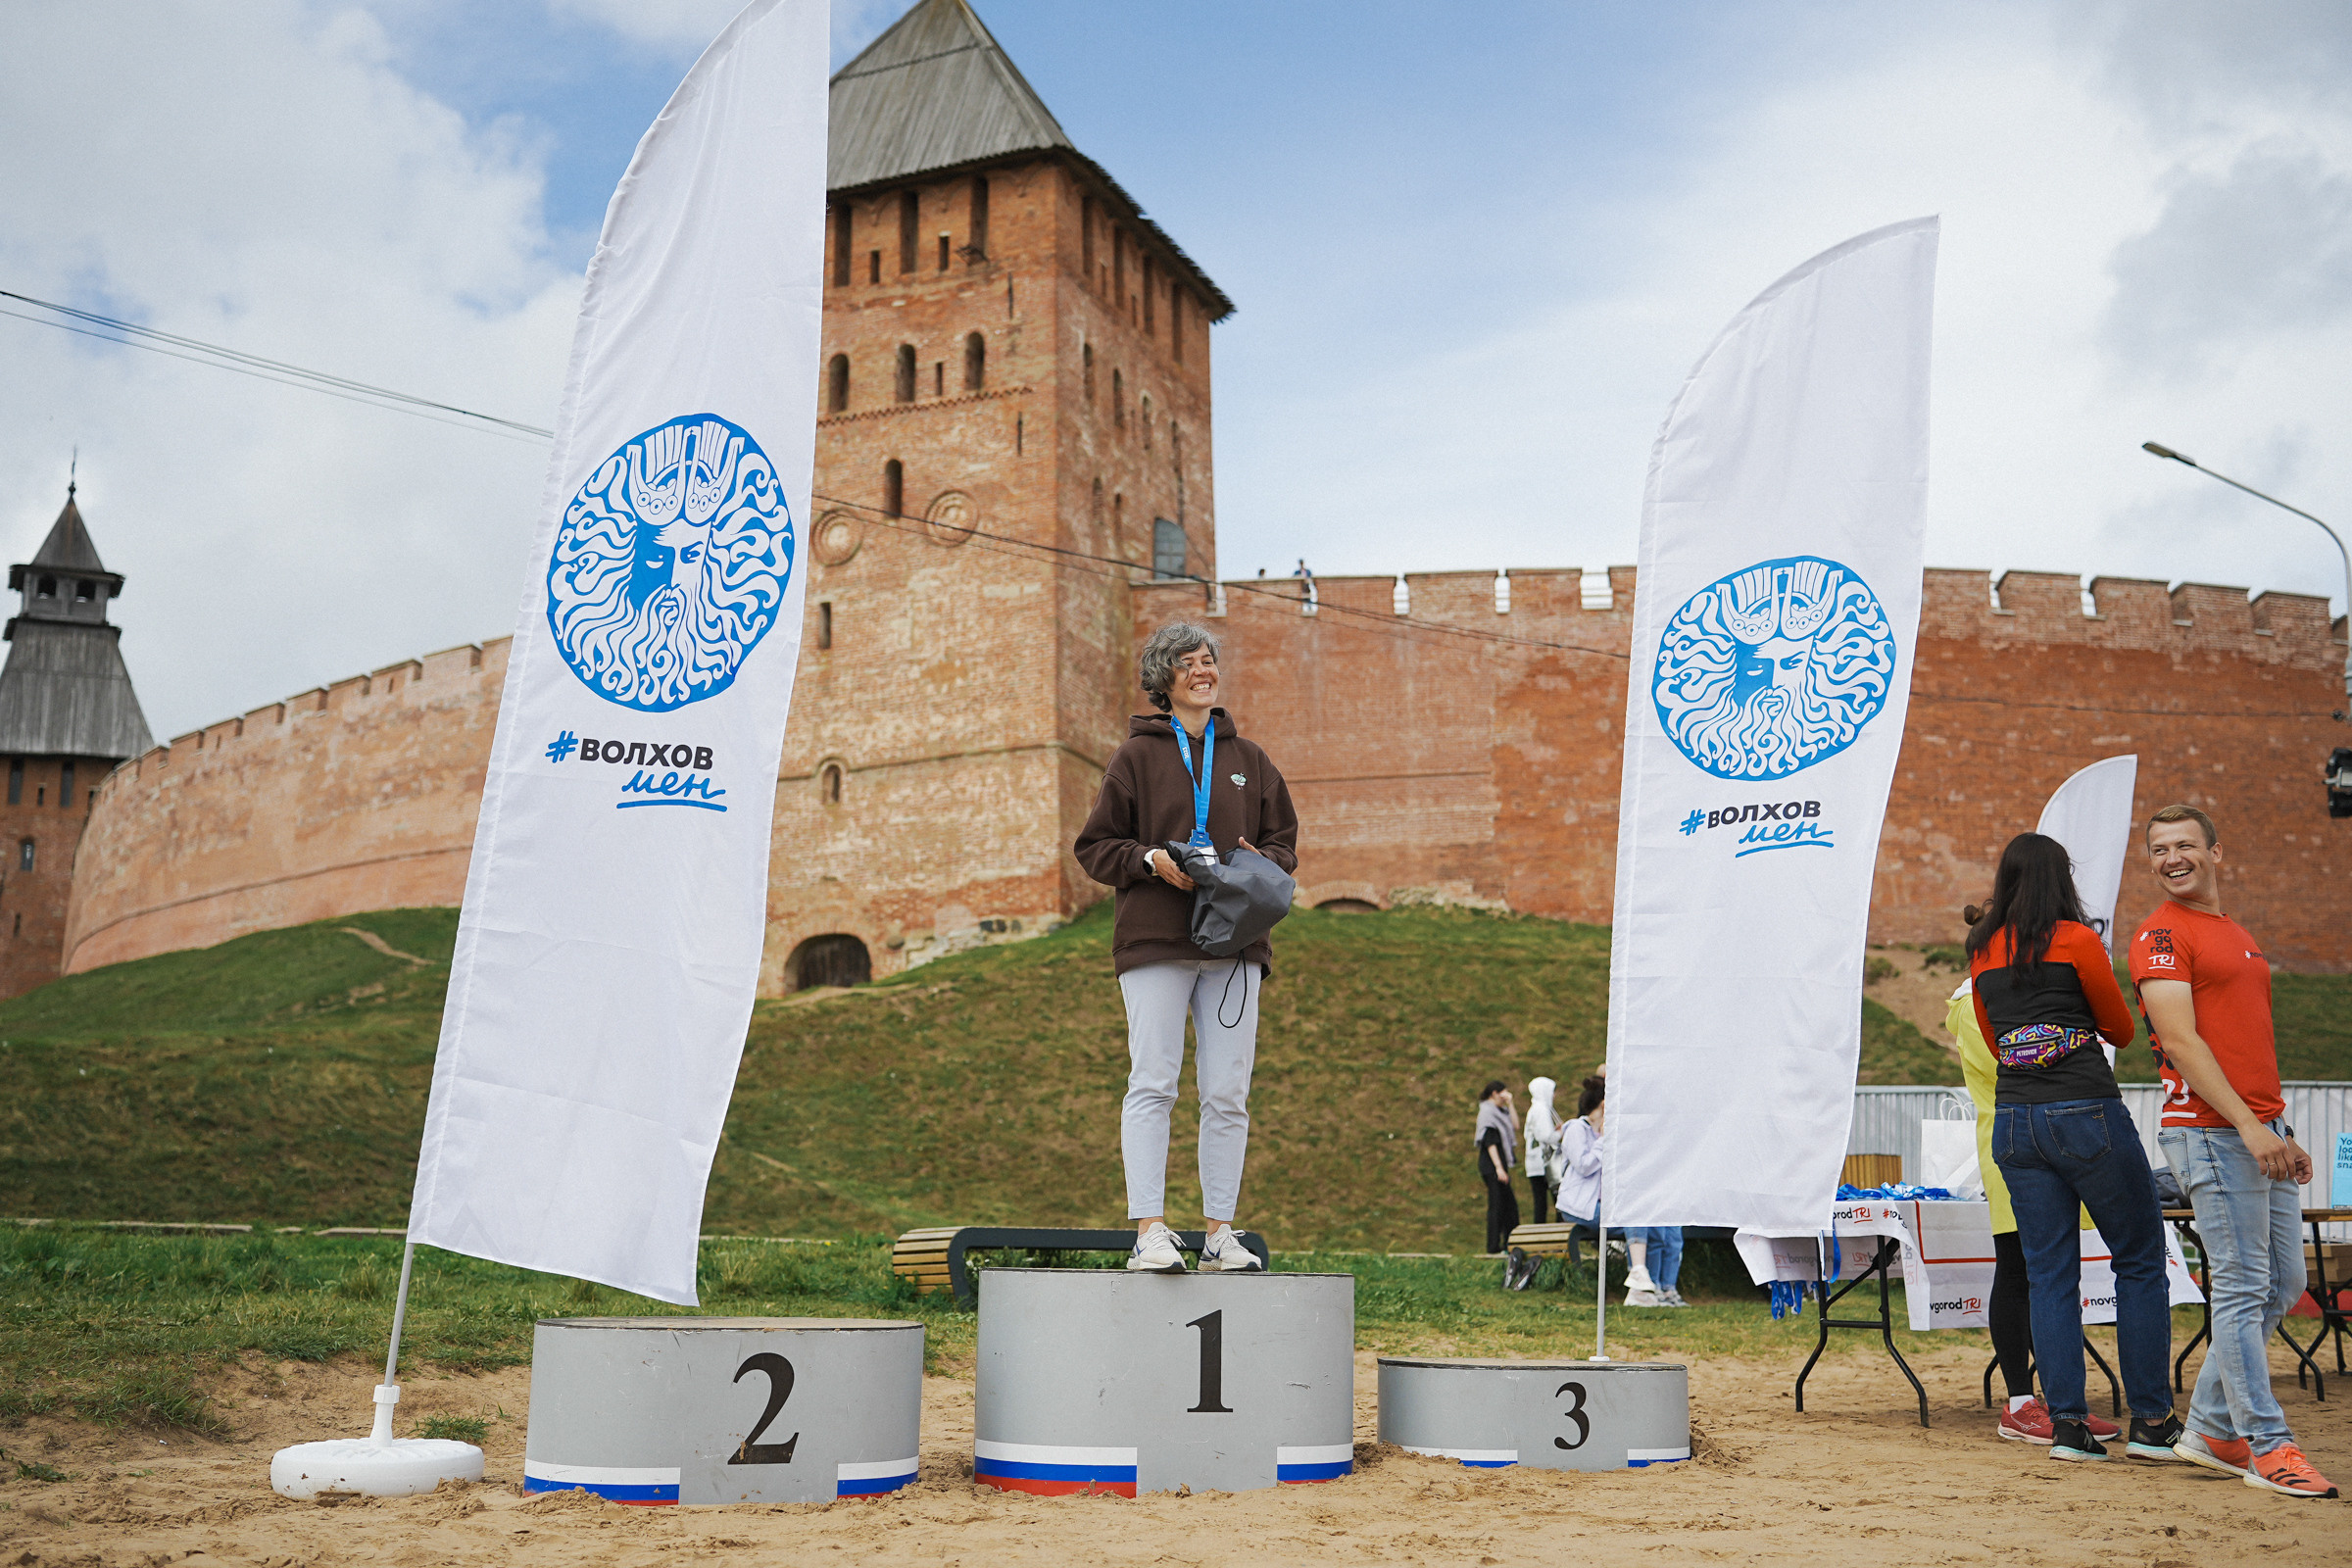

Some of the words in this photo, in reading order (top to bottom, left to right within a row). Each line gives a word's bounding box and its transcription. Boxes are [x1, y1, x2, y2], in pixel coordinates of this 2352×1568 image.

[545, 730, 713, 770] #ВОЛХОВ
[621, 769, 726, 800] мен
[1679, 801, 1822, 836] #ВОЛХОВ
[1738, 821, 1834, 845] мен
[2150, 943, 2174, 954] rod
[2155, 936, 2172, 946] go
[1185, 1308, 1234, 1412] 1
[727, 1352, 800, 1465] 2
[1554, 1382, 1591, 1450] 3
